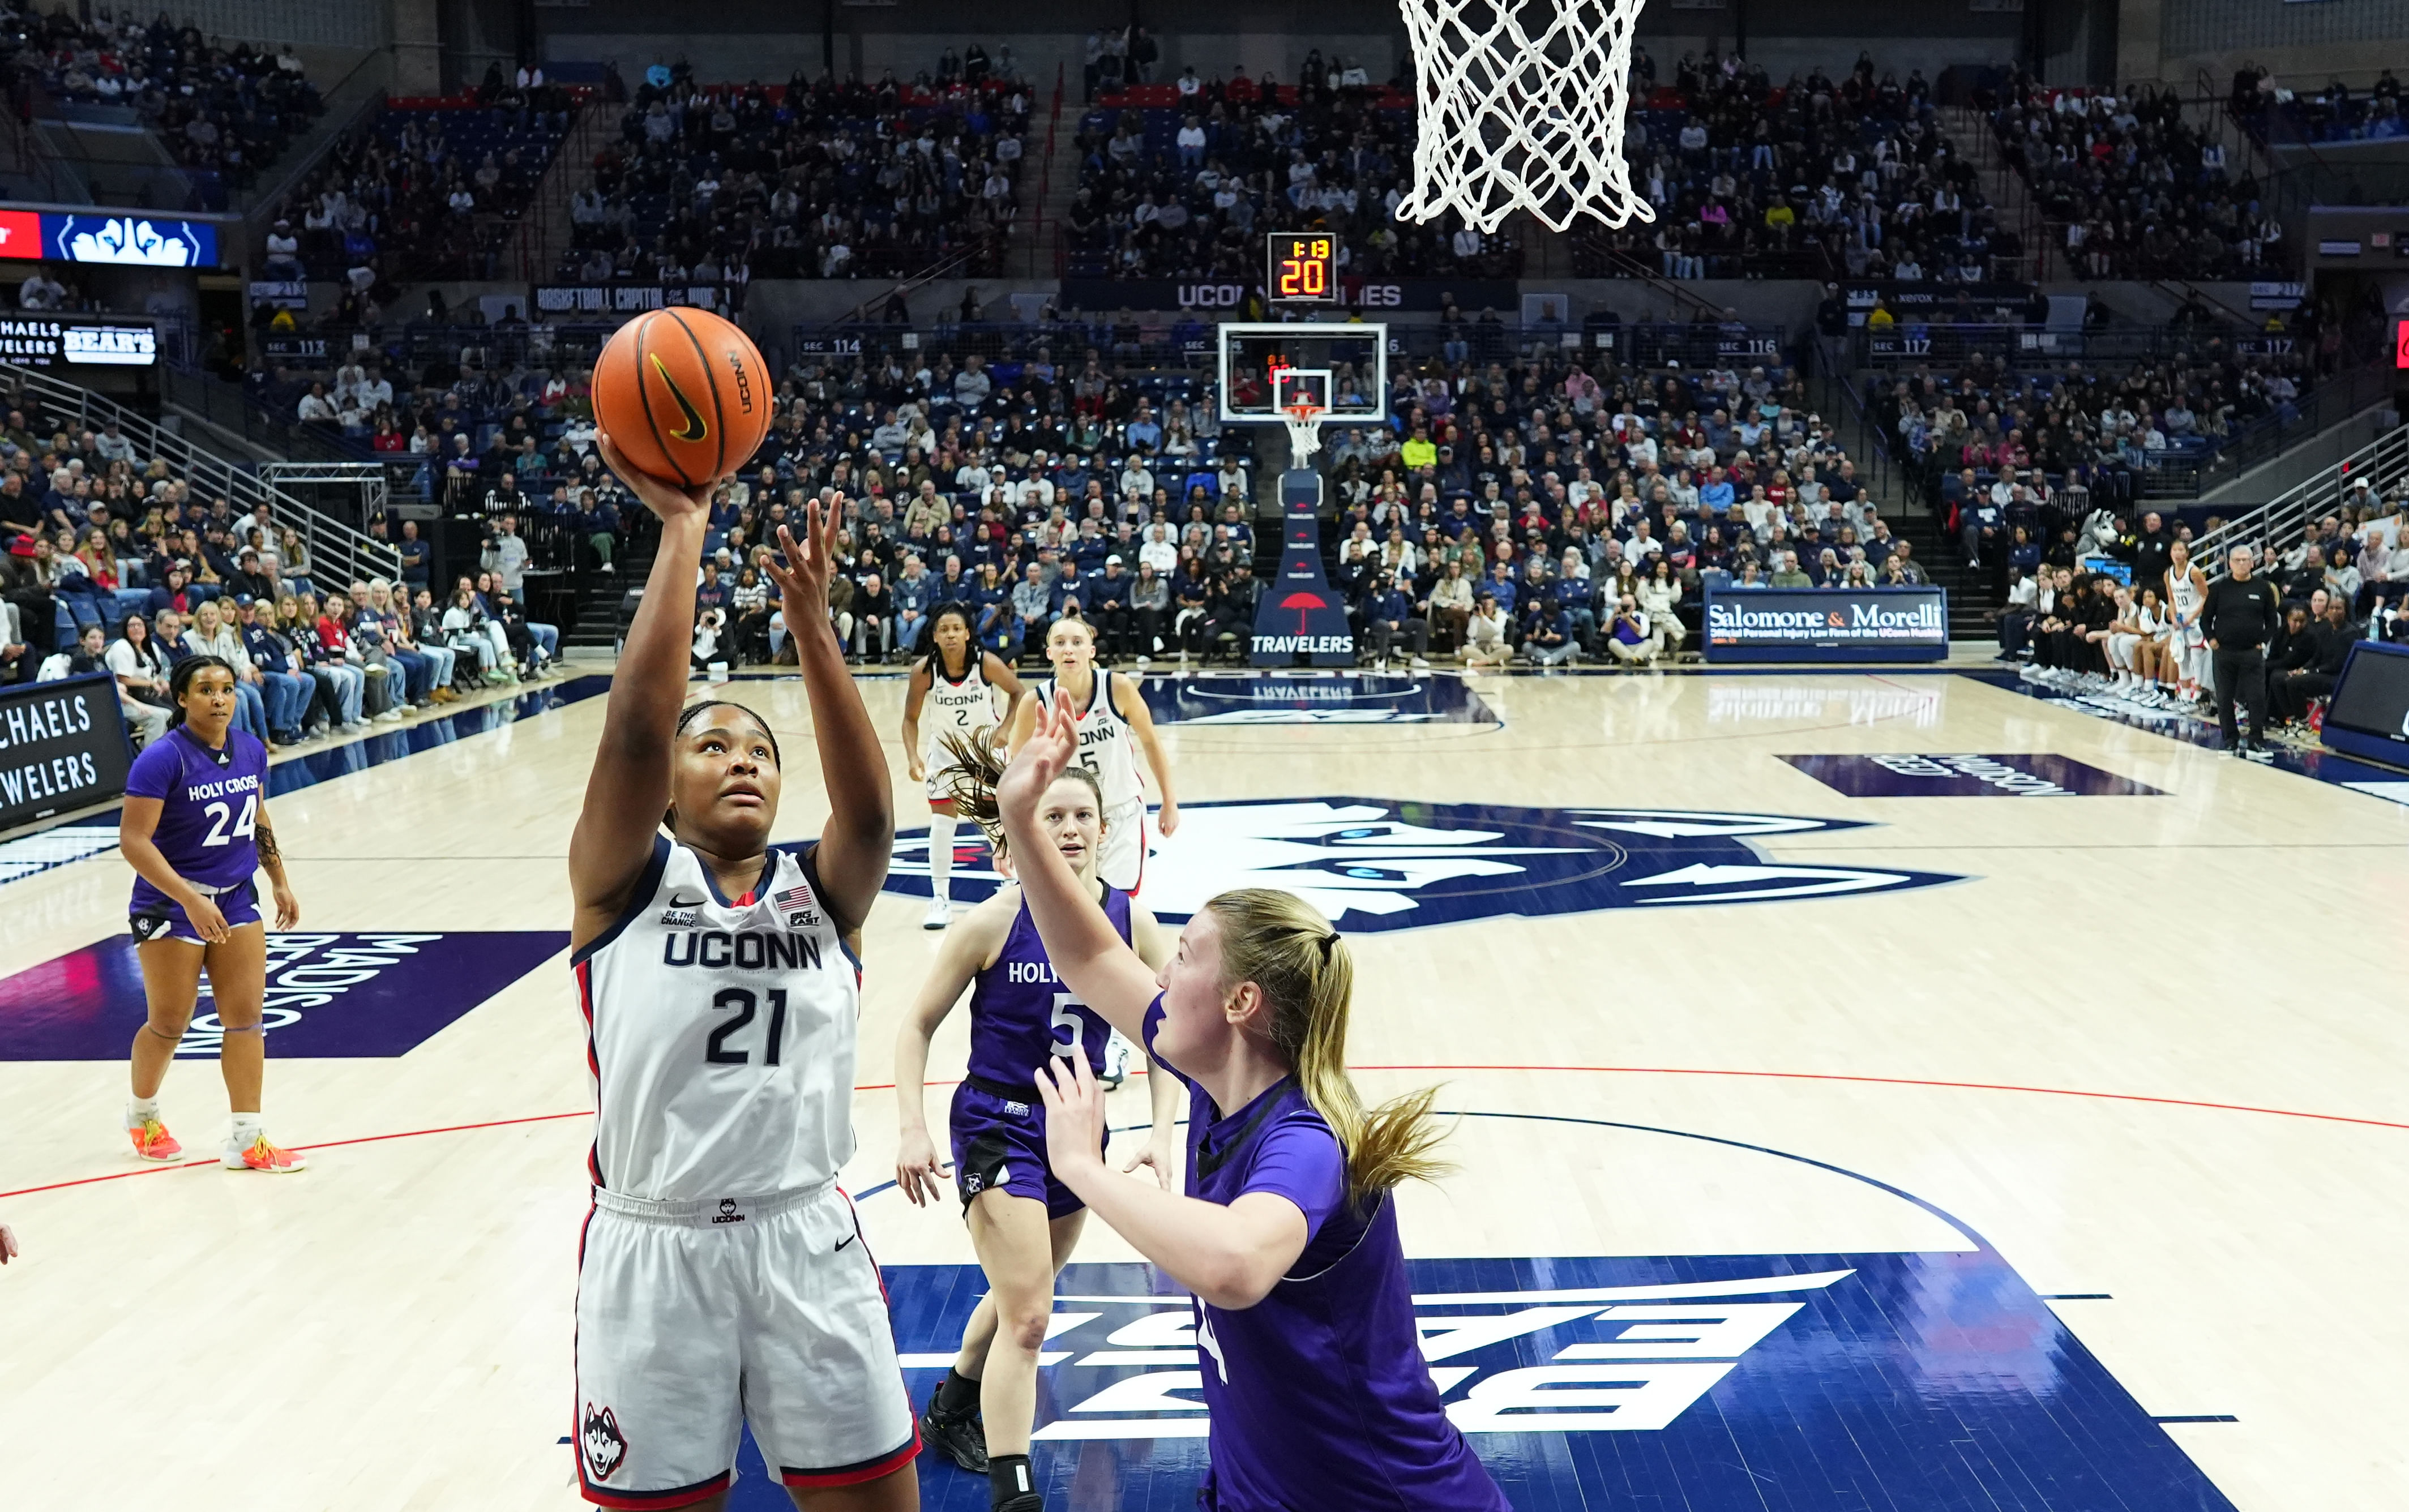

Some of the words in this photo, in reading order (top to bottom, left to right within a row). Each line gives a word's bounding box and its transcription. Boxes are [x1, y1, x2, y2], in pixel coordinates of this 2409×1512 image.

[1293, 239, 1329, 259] 1:13
[1281, 260, 1324, 294] 20
[537, 288, 610, 310] BASKETBALL
[615, 288, 663, 310] CAPITAL
[688, 287, 730, 309] WORD
[1178, 285, 1266, 306] UCO
[1898, 293, 1934, 303] xerox
[62, 331, 156, 353] BEAR'S
[267, 342, 287, 351] SEC
[299, 340, 326, 354] 113
[803, 342, 824, 351] SEC
[833, 339, 861, 353] 114
[1185, 341, 1206, 350] SEC
[1718, 342, 1739, 351] SEC
[1748, 340, 1776, 354] 116
[1874, 342, 1894, 351] SEC
[1903, 339, 1931, 354] 117
[2266, 339, 2292, 353] 117
[728, 349, 752, 415] UCONN
[1709, 604, 1824, 628] Salomone
[1828, 611, 1846, 627] &
[1850, 604, 1942, 628] Morelli
[1743, 629, 1782, 638] Personal
[1783, 629, 1810, 639] Injury
[1829, 629, 1850, 637] Firm
[1851, 629, 1862, 637] of
[1862, 628, 1879, 637] the
[1879, 628, 1910, 637] UConn
[1250, 636, 1354, 652] TRAVELERS
[935, 692, 983, 706] UCONN
[0, 695, 91, 749] HAELS
[955, 709, 969, 726] 2
[1079, 726, 1114, 746] ONN
[0, 751, 97, 809] WELERS
[189, 781, 223, 802] HOLY
[225, 774, 258, 794] CROSS
[202, 794, 258, 847] 24
[661, 916, 696, 928] CHANGE
[679, 911, 696, 920] THE
[790, 911, 811, 920] BIG
[790, 916, 820, 926] EAST
[662, 931, 823, 971] UCONN
[1009, 962, 1058, 983] HOLY
[705, 987, 788, 1066] 21
[1050, 993, 1085, 1057] 5
[712, 1214, 745, 1223] UCONN
[1030, 1362, 1738, 1441] BG
